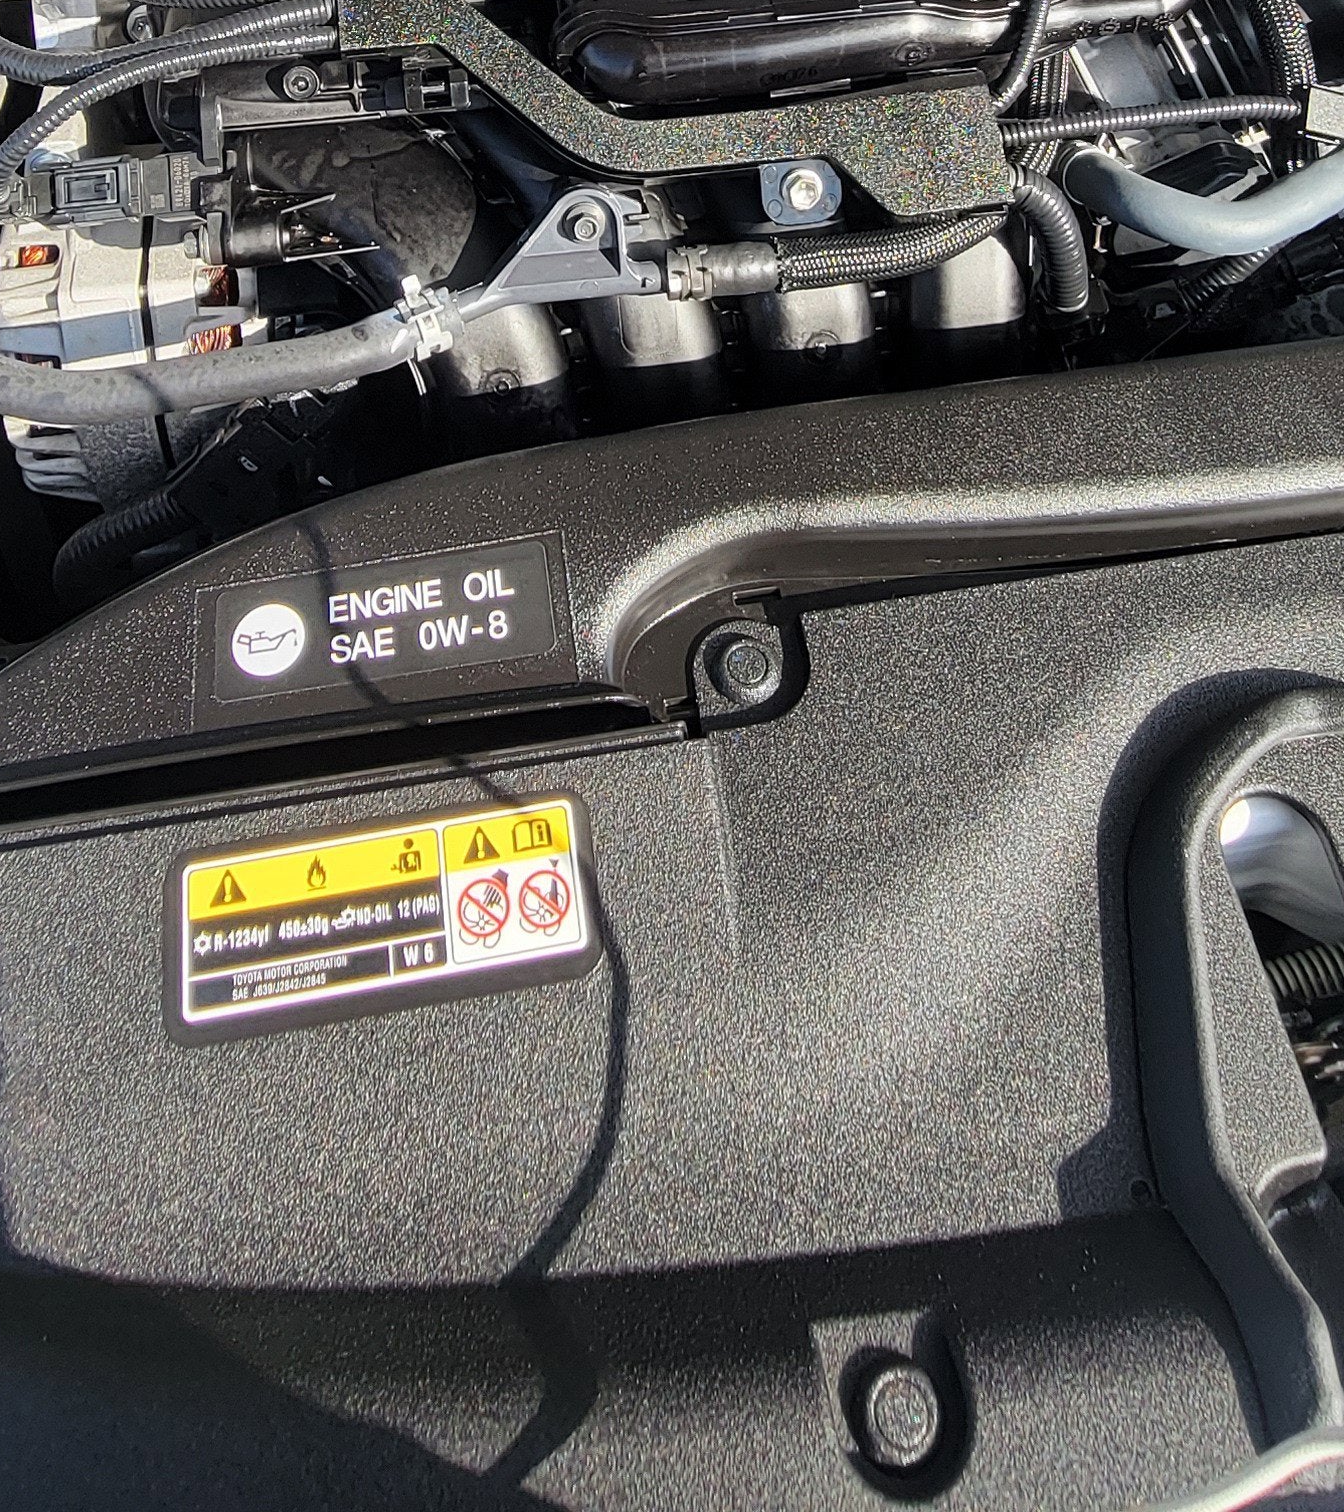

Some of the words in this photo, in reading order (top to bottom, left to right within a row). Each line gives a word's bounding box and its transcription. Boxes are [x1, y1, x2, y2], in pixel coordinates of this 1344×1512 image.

[328, 578, 443, 625] ENGINE
[462, 569, 515, 603] OIL
[329, 622, 396, 665] SAE
[417, 609, 510, 652] 0W-8
[398, 897, 410, 918] 12
[403, 946, 419, 967] W
[423, 944, 435, 964] 6
[232, 968, 263, 986] TOYOTA
[263, 963, 292, 981] MOTOR
[292, 954, 348, 976] CORPORATION
[232, 987, 249, 1001] SAE
